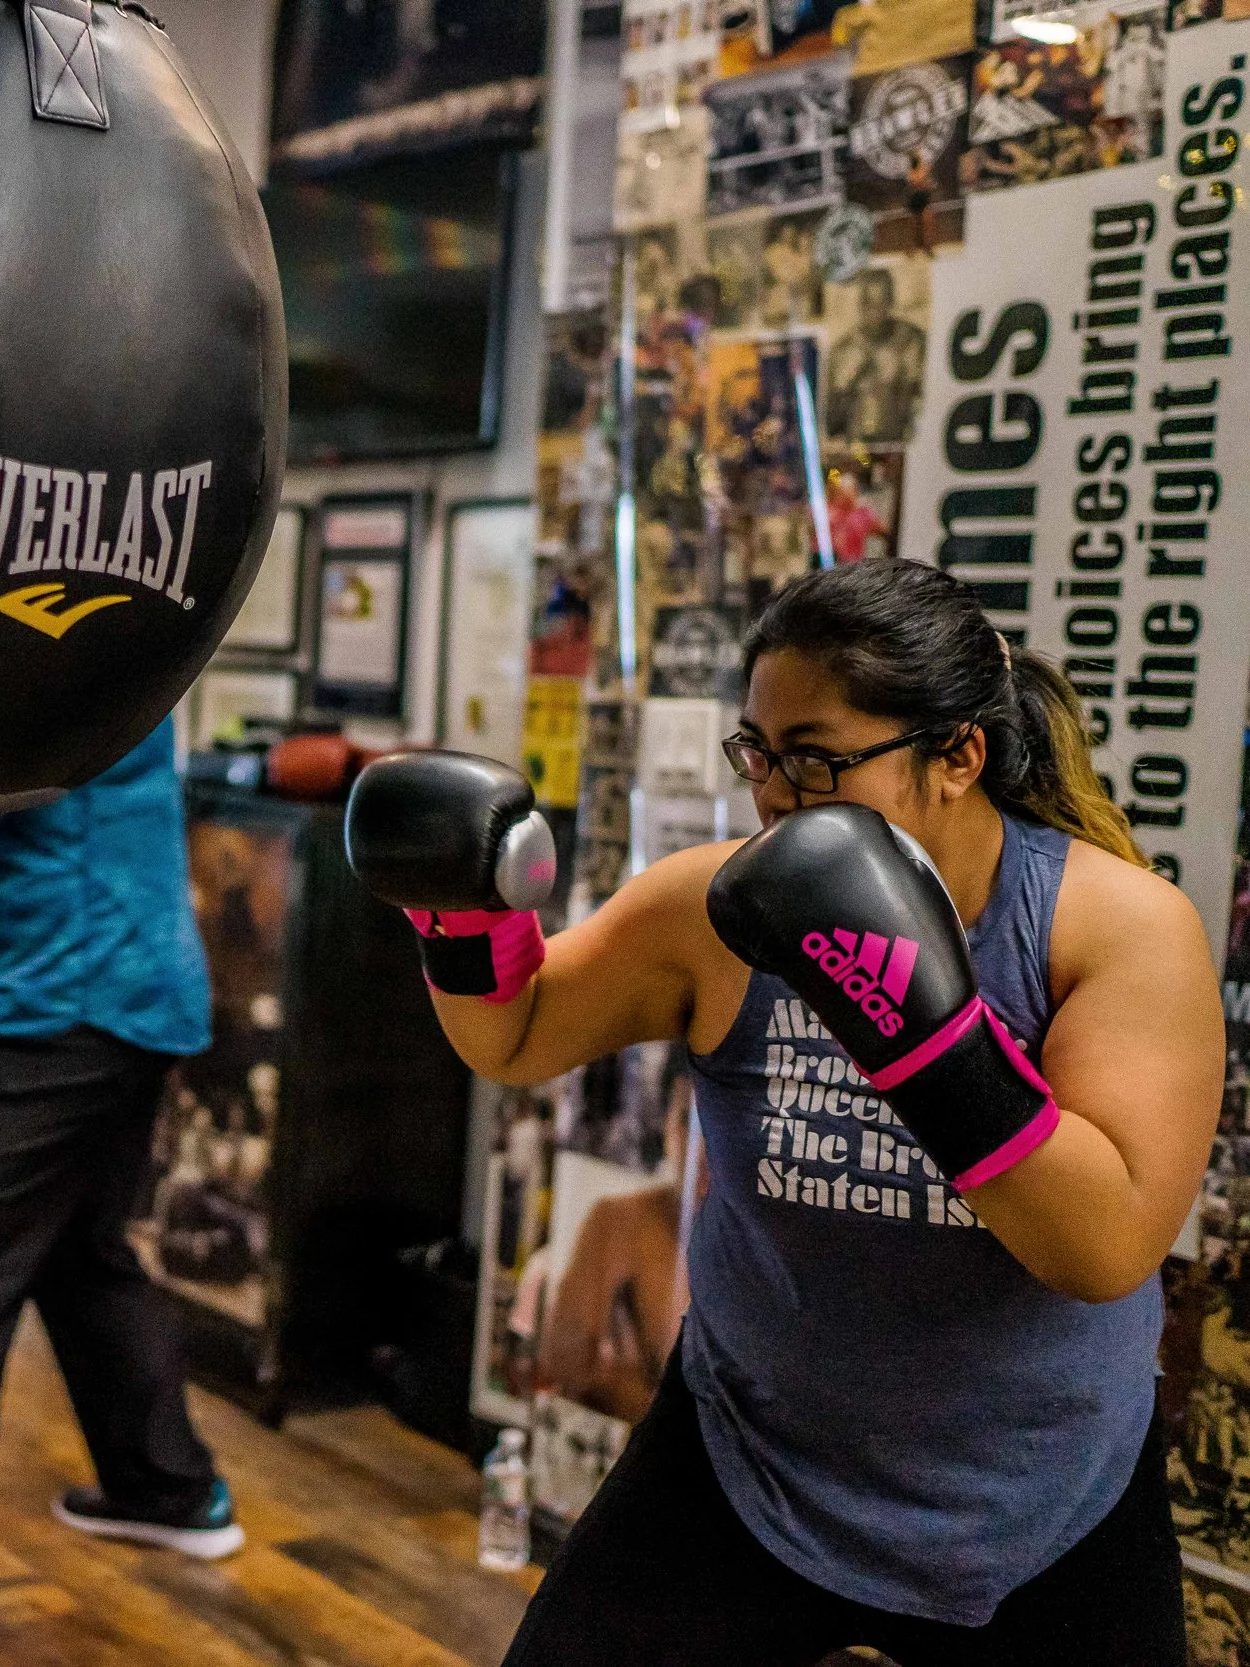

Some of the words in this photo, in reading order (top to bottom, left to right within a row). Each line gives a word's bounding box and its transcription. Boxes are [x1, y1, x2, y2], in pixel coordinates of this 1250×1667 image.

[1153, 54, 1247, 361] places.
[1067, 203, 1156, 416] bring
[1136, 378, 1221, 577] right
[1126, 603, 1201, 728] the
[1124, 757, 1187, 827] to
[802, 931, 904, 1037] adidas
[757, 1158, 911, 1219] Staten
[761, 1115, 849, 1165] The
